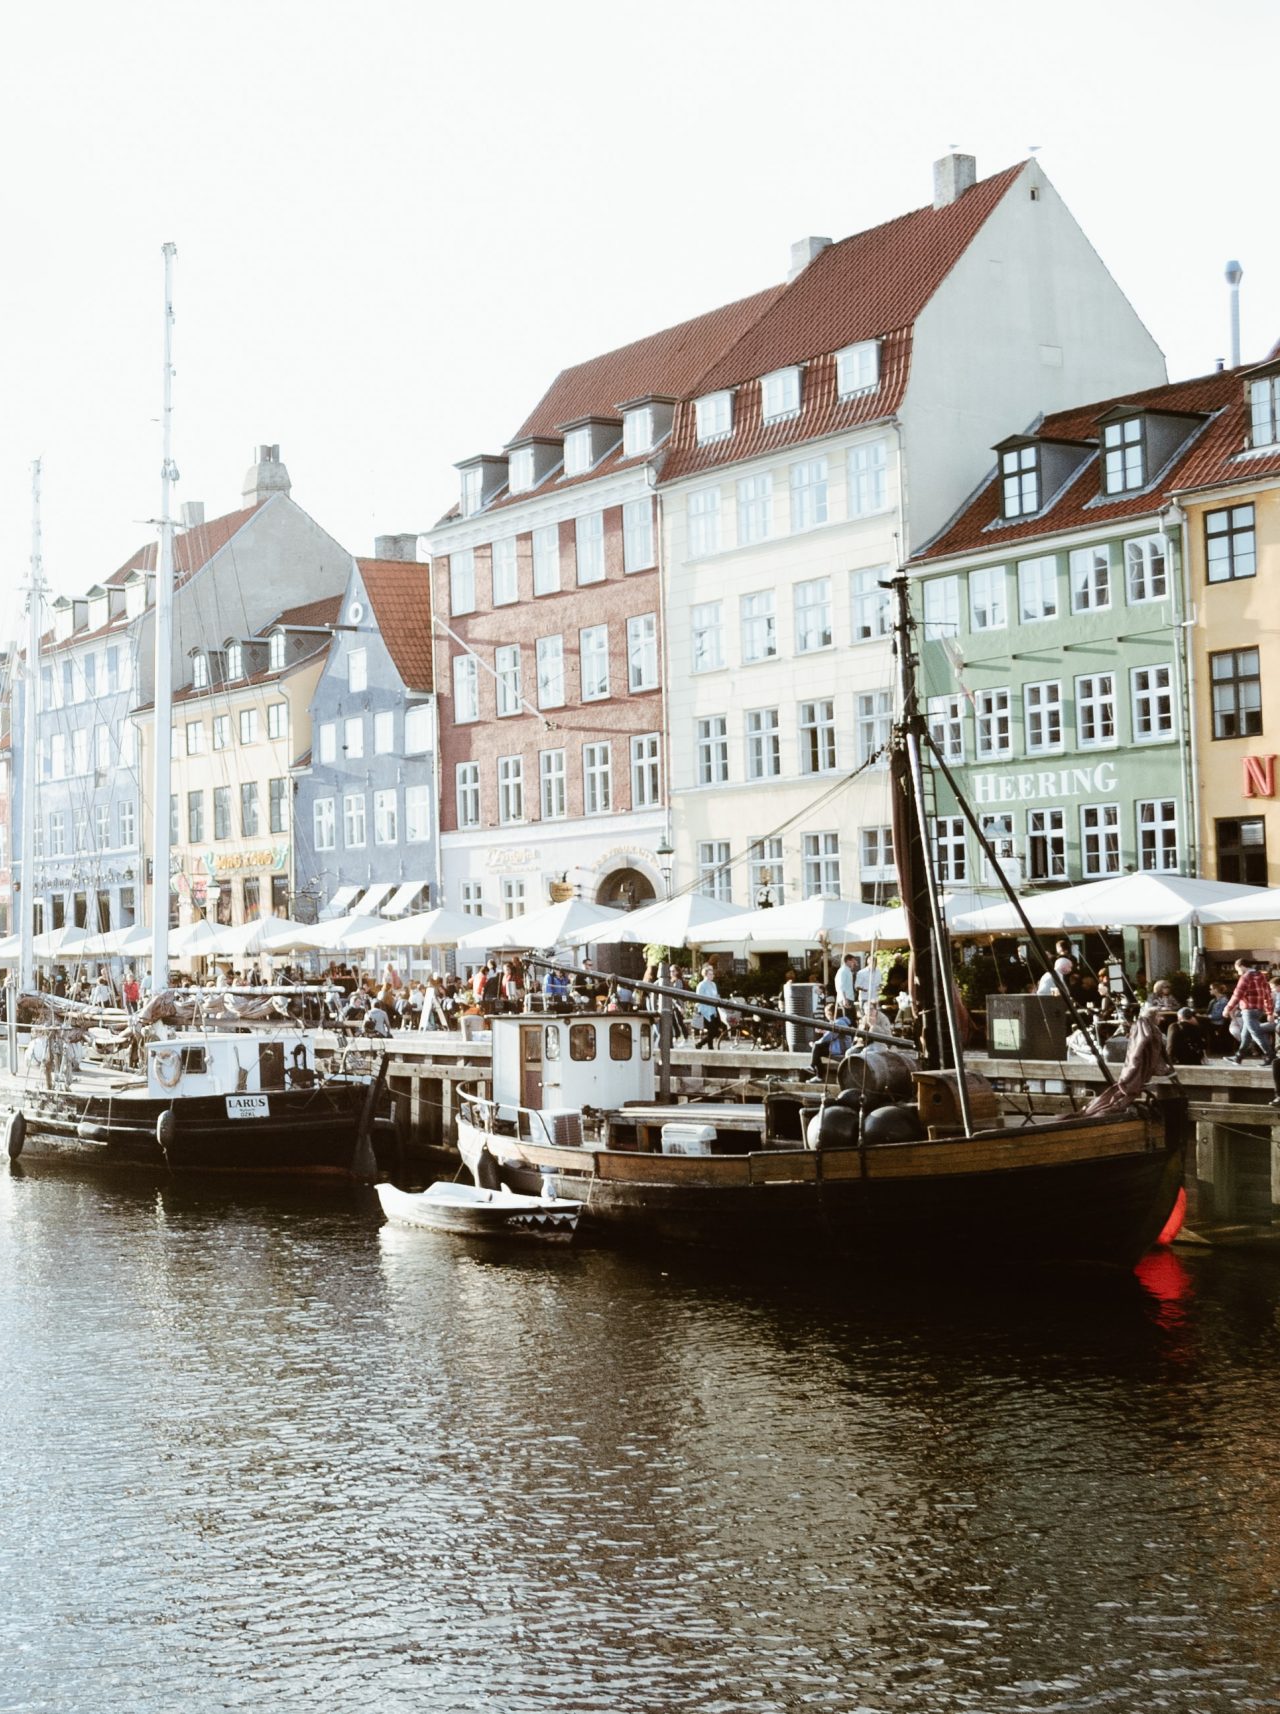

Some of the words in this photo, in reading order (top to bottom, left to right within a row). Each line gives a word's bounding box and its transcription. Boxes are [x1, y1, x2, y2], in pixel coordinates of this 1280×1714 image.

[972, 761, 1118, 804] HEERING
[1240, 754, 1277, 798] N
[228, 1098, 266, 1108] LARUS
